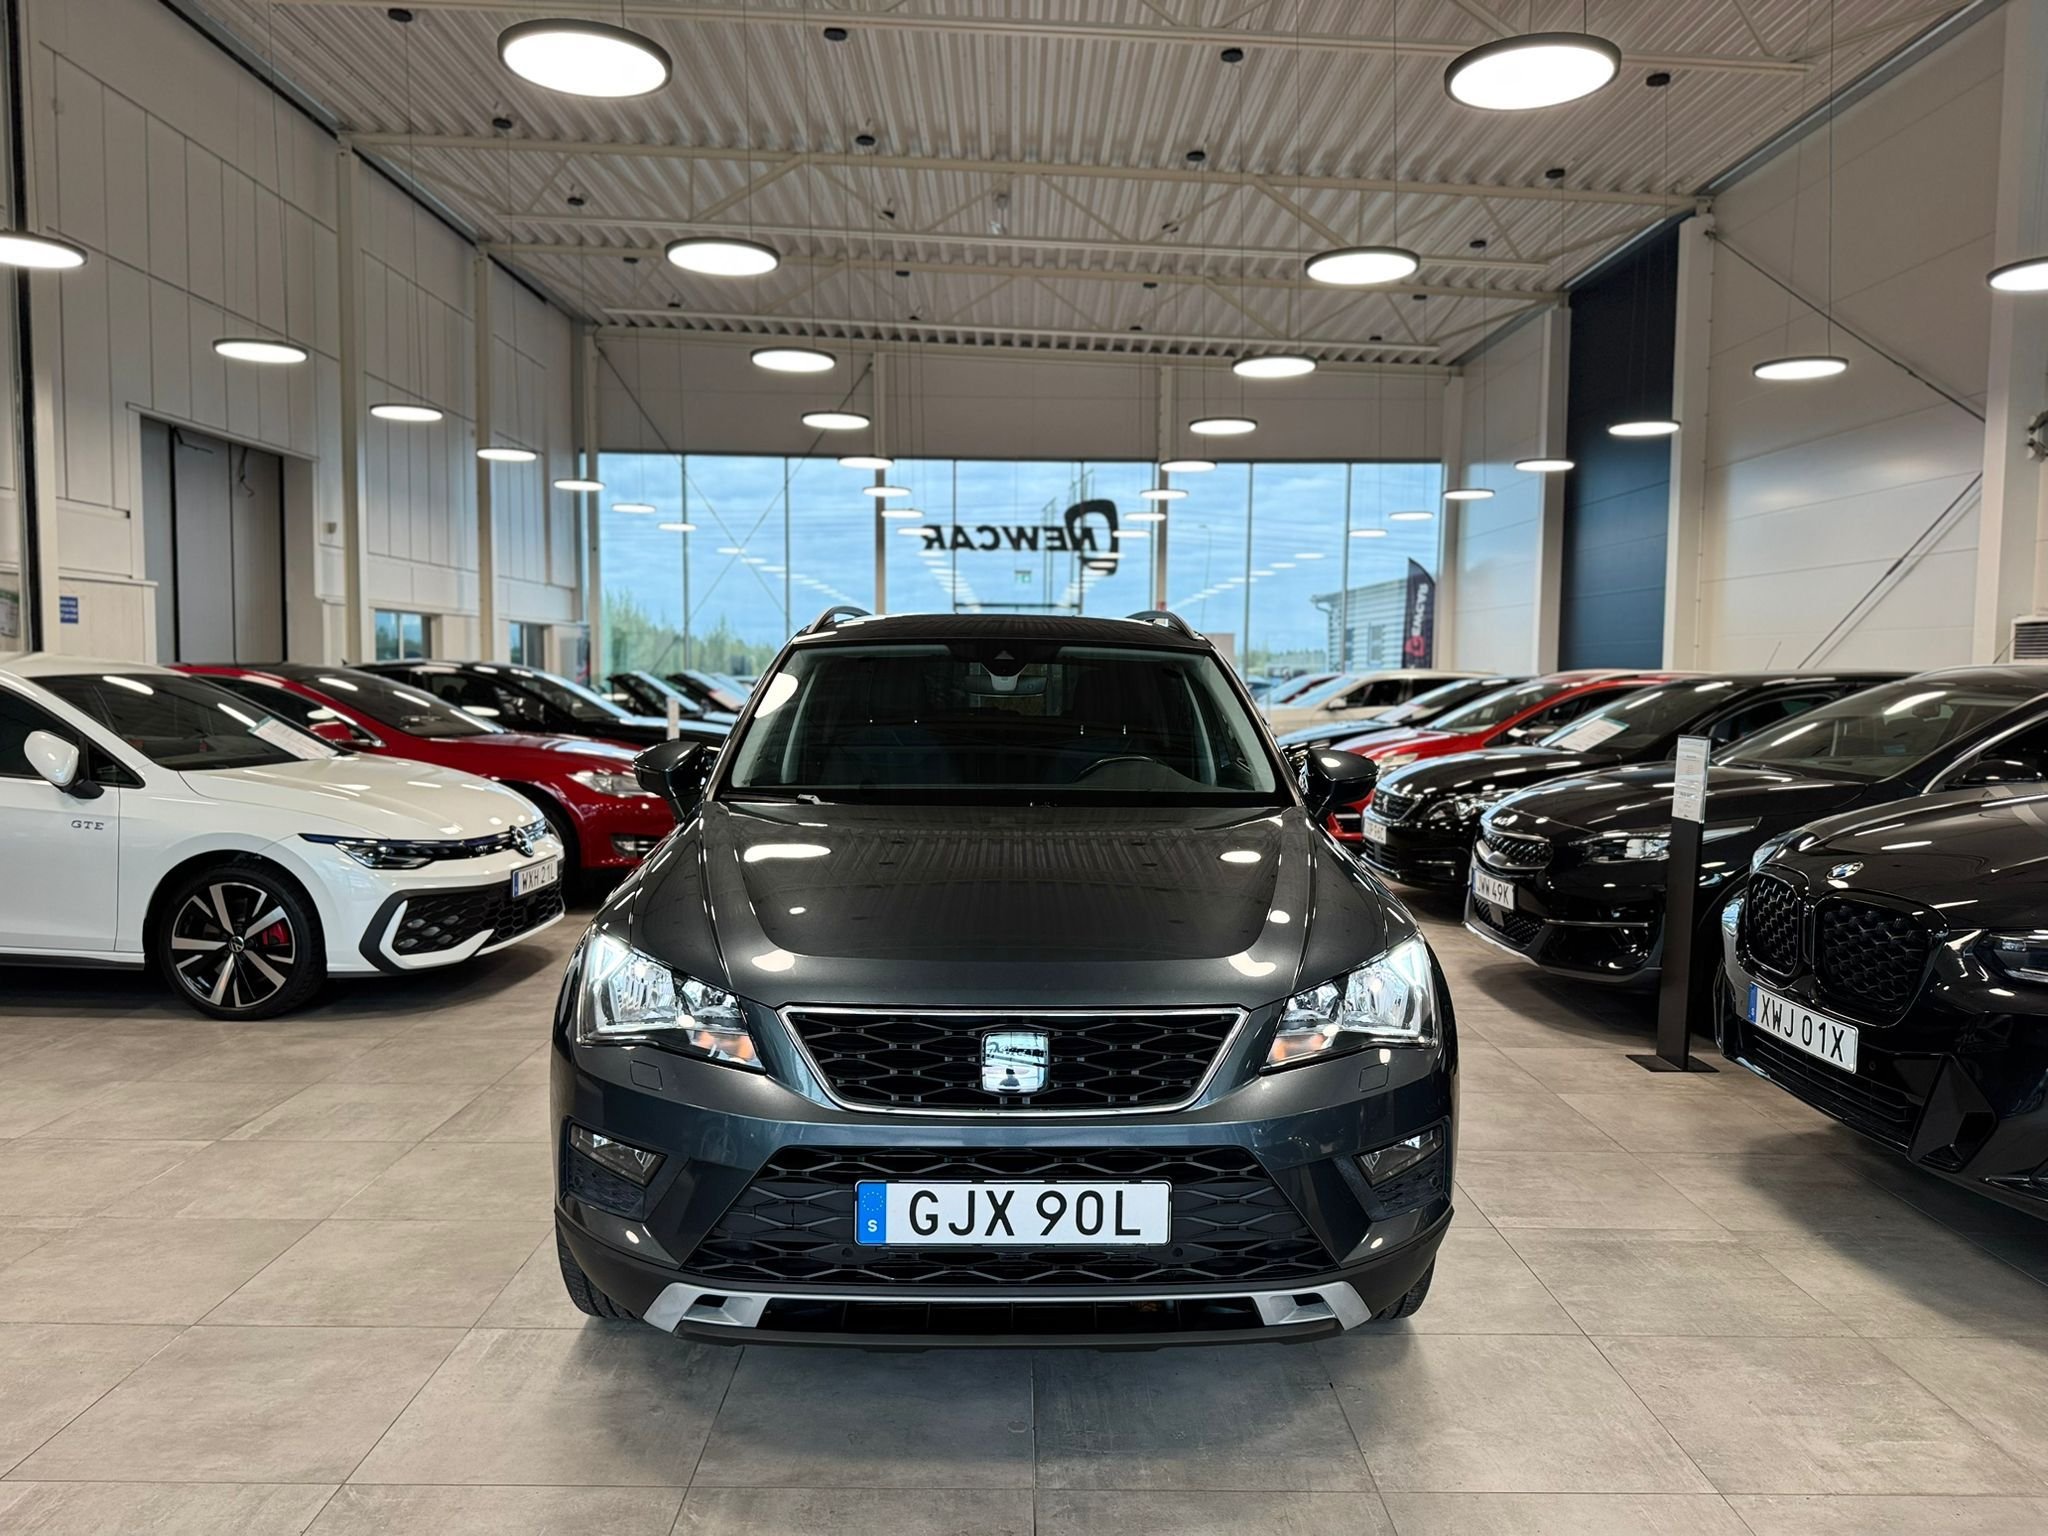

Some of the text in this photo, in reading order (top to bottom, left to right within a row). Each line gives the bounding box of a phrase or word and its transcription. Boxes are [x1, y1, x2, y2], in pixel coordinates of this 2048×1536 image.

[71, 820, 104, 830] GTE
[1492, 881, 1509, 905] 49K
[1761, 994, 1844, 1062] XWJ 01X
[909, 1190, 1141, 1236] GJX 90L
[867, 1221, 877, 1232] S
